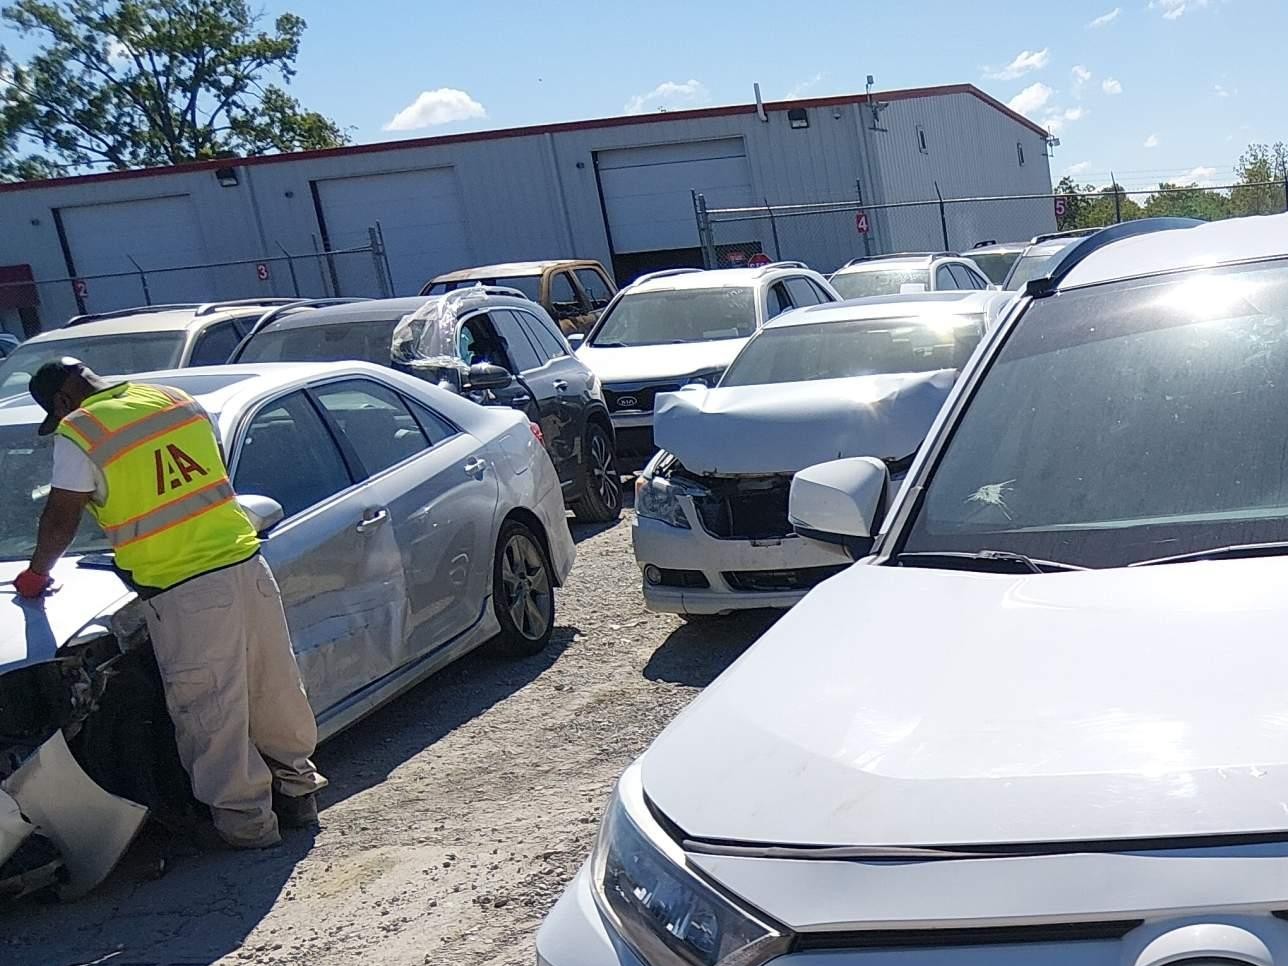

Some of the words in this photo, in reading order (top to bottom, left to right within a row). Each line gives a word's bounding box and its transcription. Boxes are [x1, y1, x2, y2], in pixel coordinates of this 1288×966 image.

[1055, 200, 1065, 215] 5
[858, 215, 867, 231] 4
[257, 264, 268, 279] 3
[77, 282, 88, 297] 2
